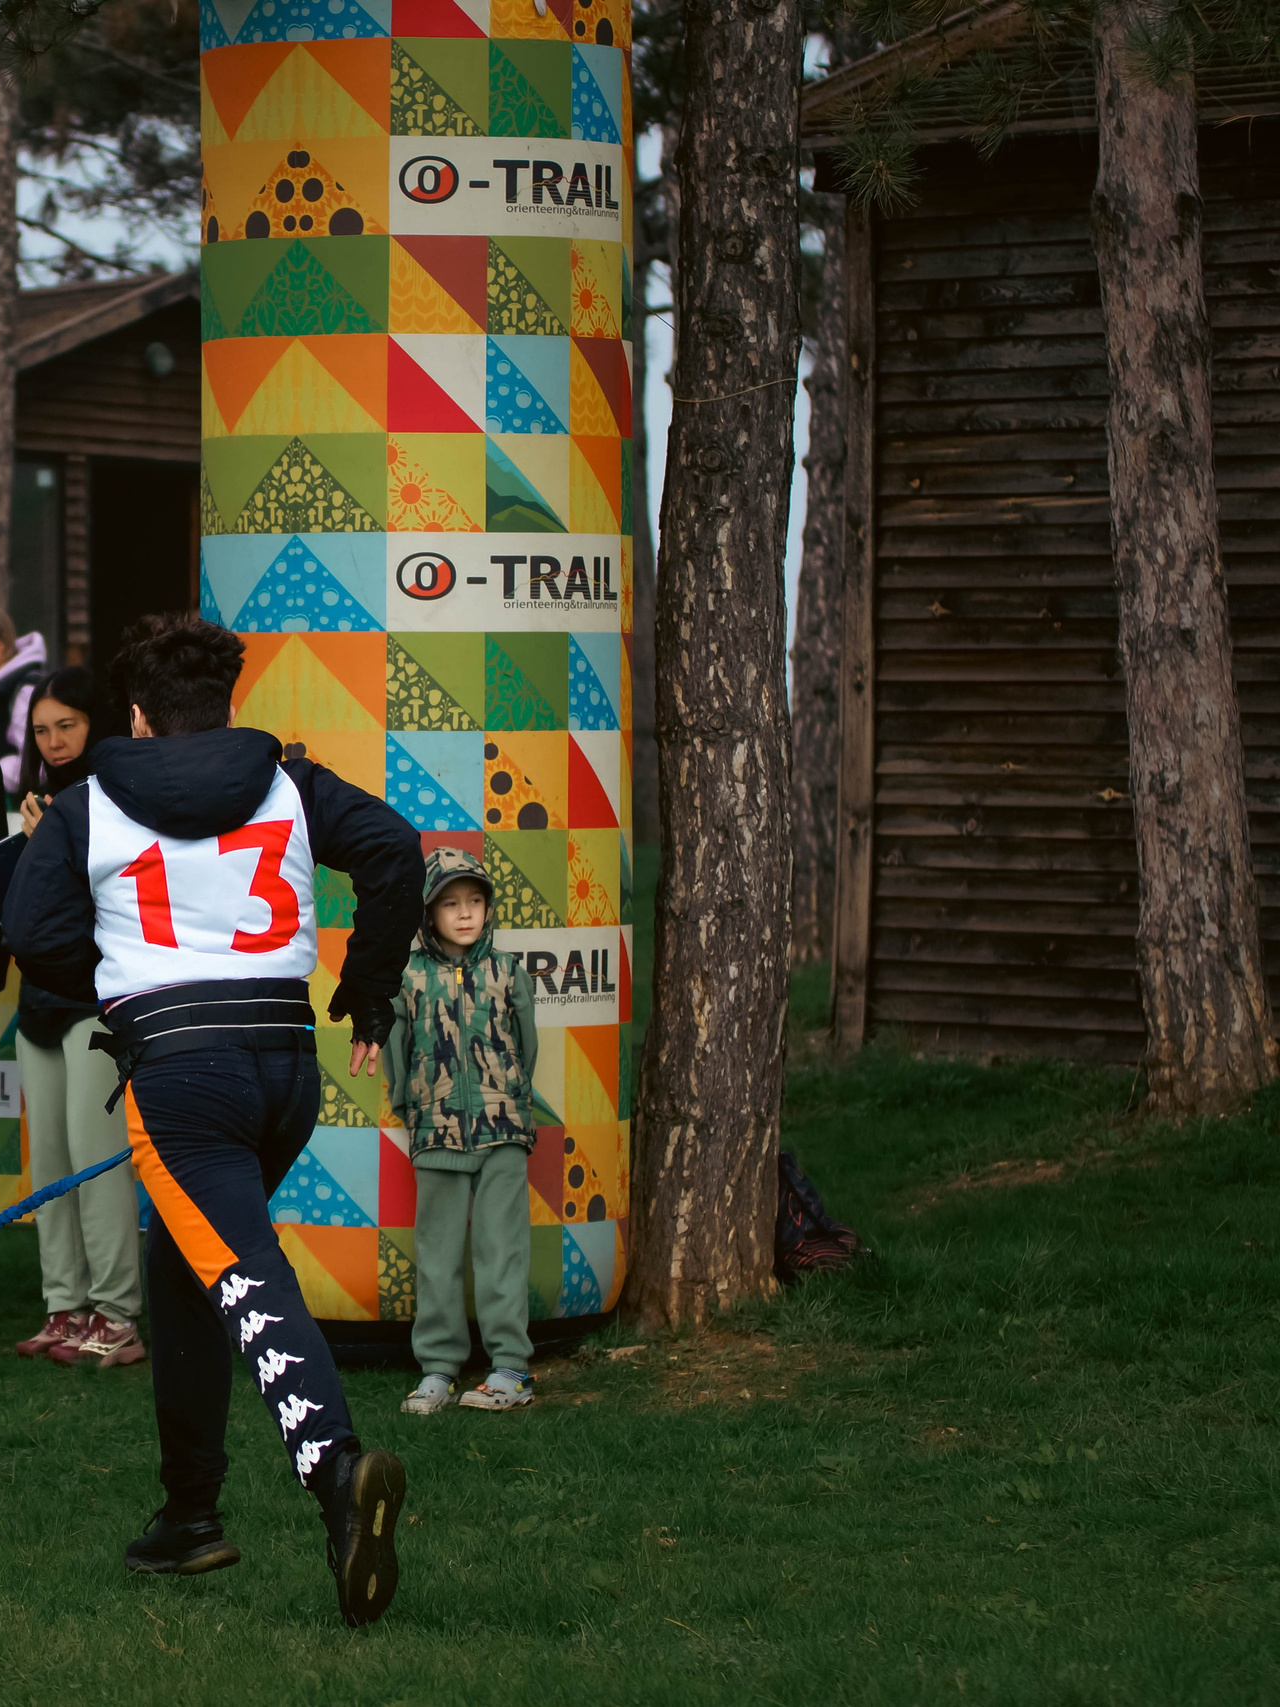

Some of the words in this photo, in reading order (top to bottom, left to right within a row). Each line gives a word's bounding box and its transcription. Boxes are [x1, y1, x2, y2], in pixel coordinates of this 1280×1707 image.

[506, 203, 619, 221] orienteering&trailrunning
[504, 600, 617, 612] orienteering&trailrunning
[117, 819, 300, 954] 13
